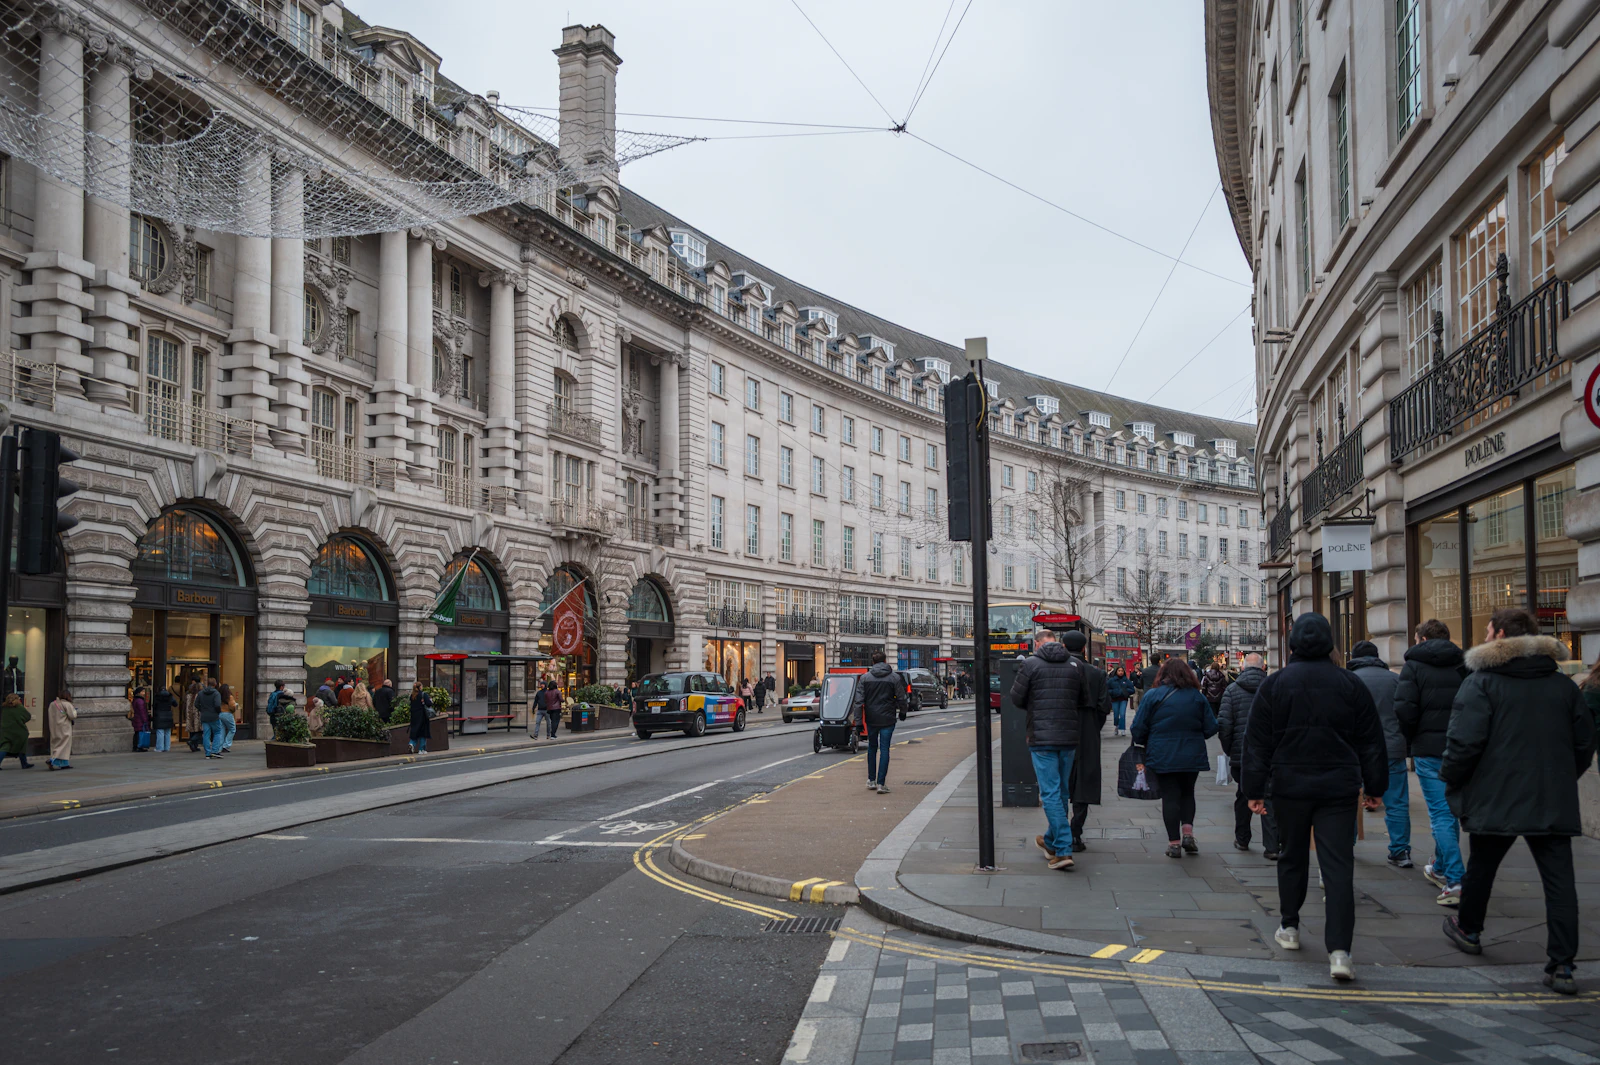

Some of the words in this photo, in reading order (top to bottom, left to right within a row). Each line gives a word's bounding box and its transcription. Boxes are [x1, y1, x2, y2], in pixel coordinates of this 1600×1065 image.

[1465, 431, 1505, 467] POLÈNE
[1328, 542, 1366, 553] POLÈNE
[177, 590, 217, 605] Barbour
[338, 604, 368, 617] Barbour
[461, 614, 485, 625] Barbour
